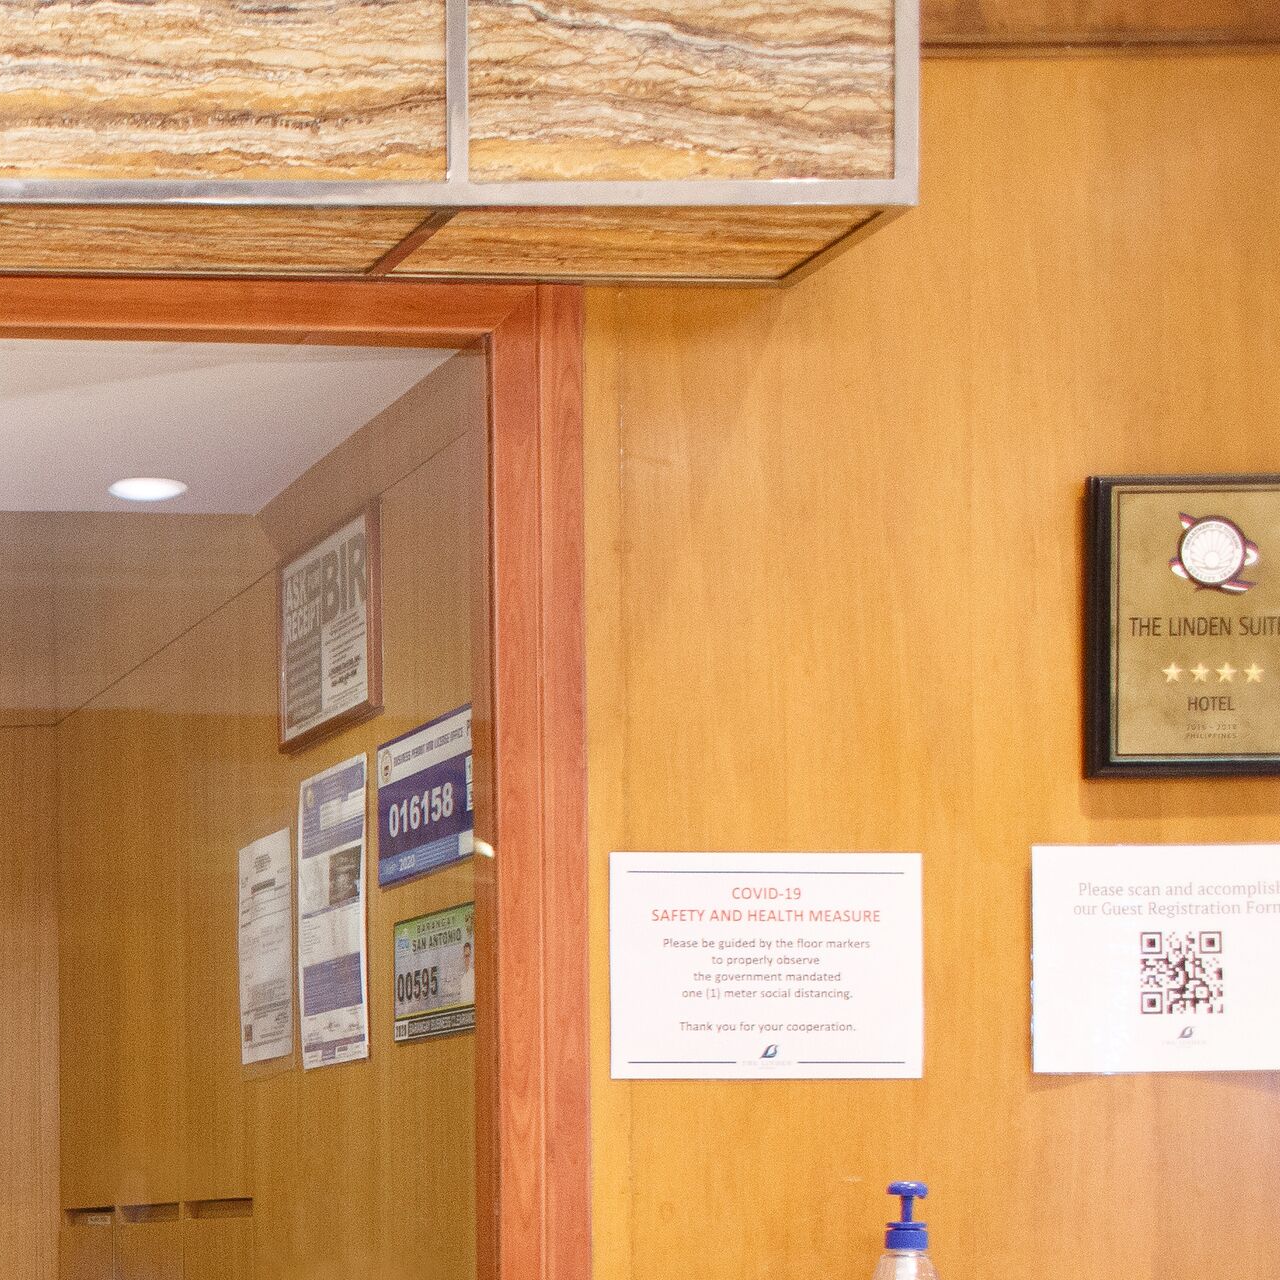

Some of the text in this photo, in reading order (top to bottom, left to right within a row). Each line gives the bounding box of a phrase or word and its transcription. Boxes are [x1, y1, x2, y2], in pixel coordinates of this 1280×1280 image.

[321, 532, 367, 626] BIR
[1128, 615, 1280, 637] THE LINDEN SUIT
[1187, 696, 1236, 712] HOTEL
[389, 782, 454, 838] 016158
[732, 887, 801, 900] COVID-19
[1078, 882, 1124, 896] Please
[1127, 885, 1161, 896] scan
[1165, 881, 1193, 896] and
[651, 909, 881, 923] SAFETY AND HEALTH MEASURE
[1073, 904, 1098, 915] our
[1101, 901, 1143, 916] Guest
[1148, 900, 1241, 919] Registration
[412, 938, 427, 953] SAN
[429, 928, 462, 950] ANTONIO
[663, 938, 871, 950] Please be guided by the floor markers
[711, 955, 821, 967] to properly observe
[397, 965, 439, 1002] 00595
[693, 972, 842, 984] the government mandated
[682, 989, 703, 998] one
[724, 989, 757, 998] meter
[760, 988, 791, 998] social
[794, 988, 853, 1001] distancing.
[679, 1021, 856, 1034] Thank you for your cooperation.
